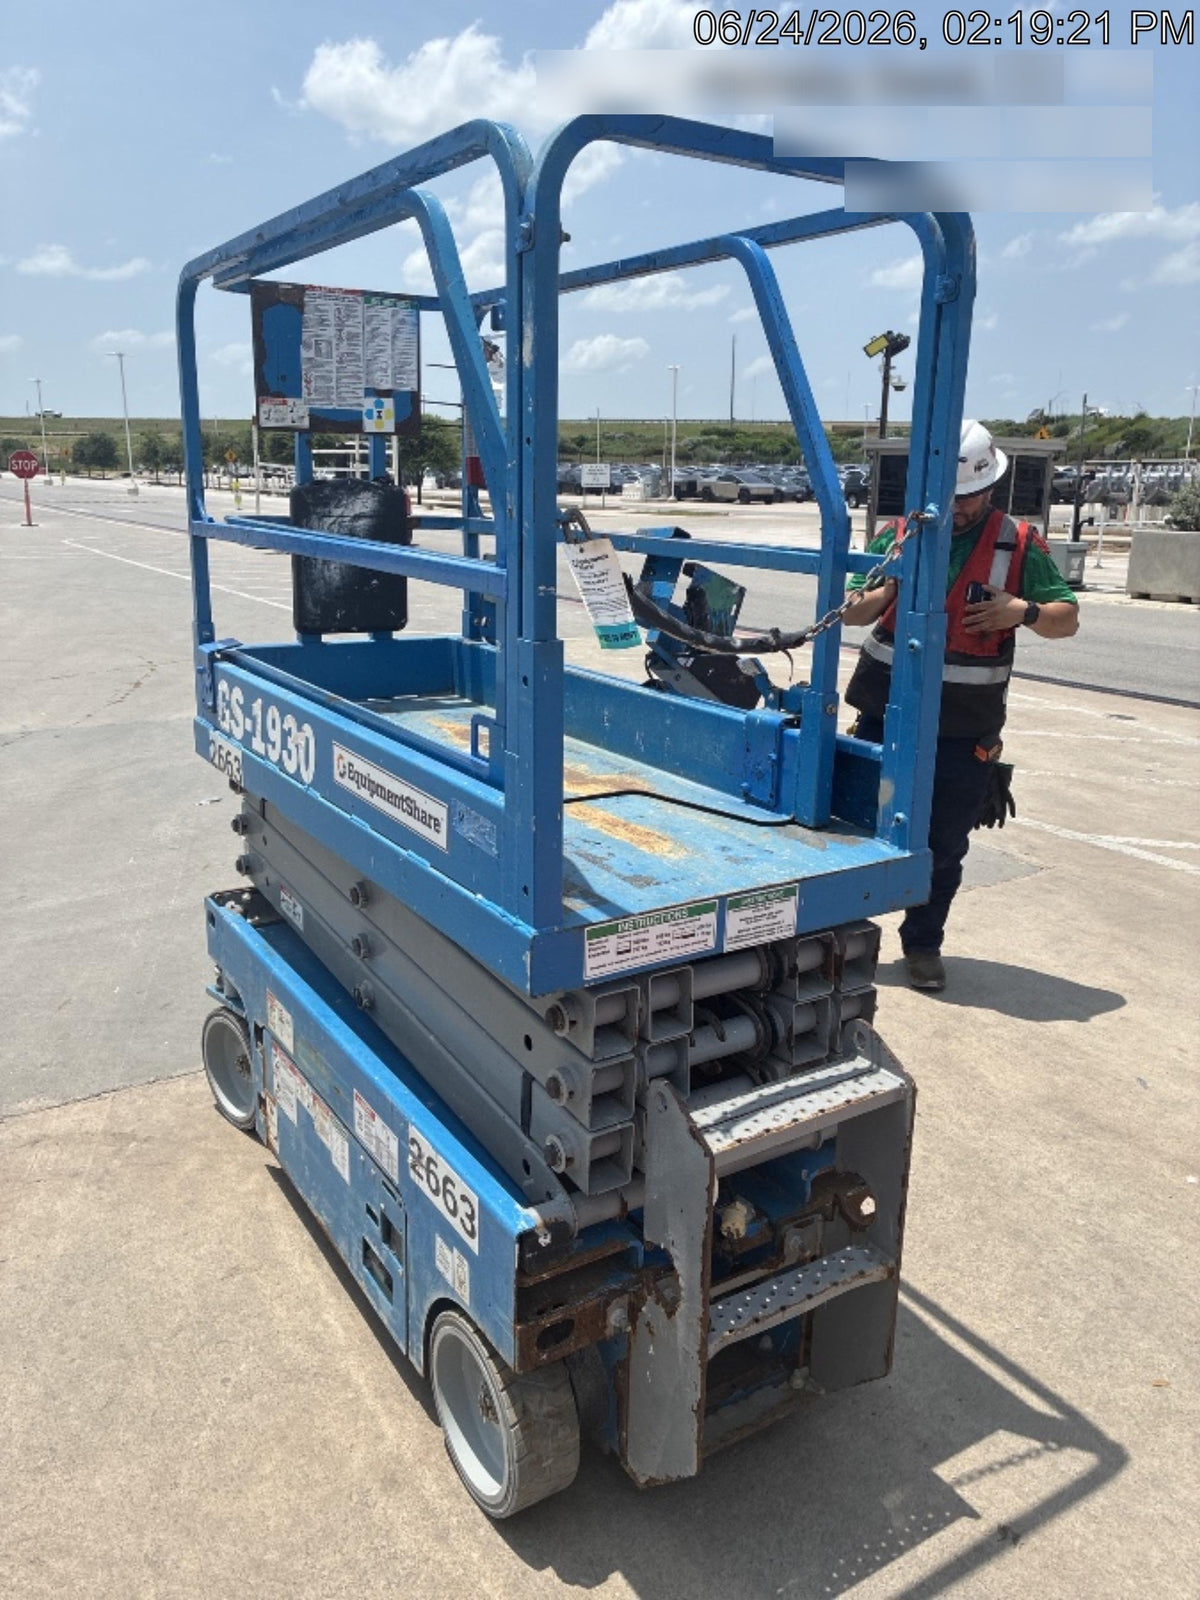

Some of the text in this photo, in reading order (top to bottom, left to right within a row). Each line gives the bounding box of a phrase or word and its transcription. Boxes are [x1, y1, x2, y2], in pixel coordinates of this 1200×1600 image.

[11, 459, 39, 472] STOP
[209, 739, 242, 784] 2663
[217, 679, 316, 784] GS-1930
[346, 762, 442, 834] EquipmentShare
[409, 1137, 477, 1241] 2663
